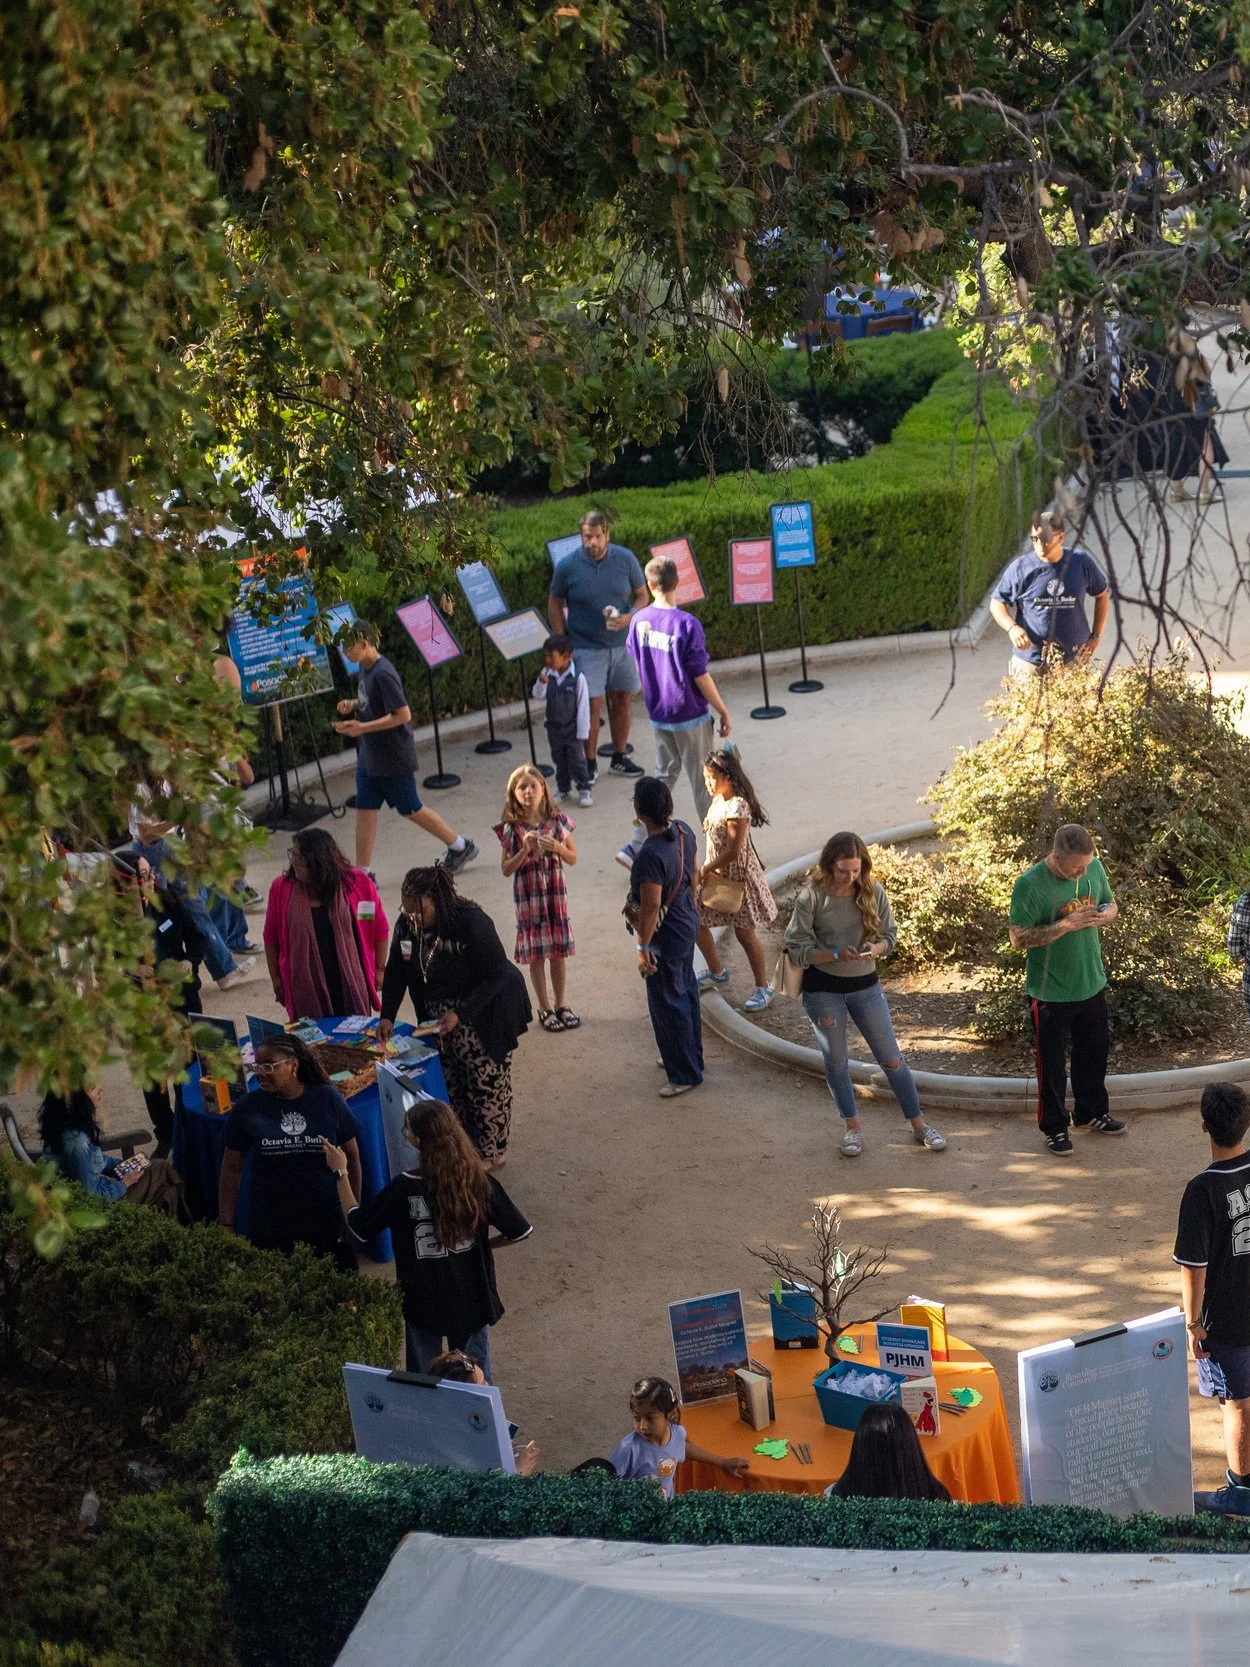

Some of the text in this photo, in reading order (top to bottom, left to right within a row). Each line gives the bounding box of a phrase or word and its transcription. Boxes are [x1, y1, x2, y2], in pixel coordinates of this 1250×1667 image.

[261, 1137, 292, 1146] Octavia
[294, 1136, 303, 1144] E.
[414, 1221, 477, 1260] 2
[719, 1320, 737, 1329] Magnet
[726, 1328, 744, 1336] connect
[728, 1334, 737, 1342] and
[886, 1352, 925, 1367] PJHM
[693, 1377, 727, 1389] Pasadena
[1091, 1394, 1121, 1411] Magnet
[1097, 1405, 1119, 1421] place
[1119, 1397, 1148, 1412] because
[1075, 1423, 1087, 1435] the
[1089, 1418, 1115, 1433] people
[1135, 1405, 1152, 1417] Our
[1101, 1427, 1116, 1437] our
[1081, 1440, 1099, 1453] staff
[1118, 1427, 1145, 1443] always
[1092, 1443, 1122, 1459] around
[1123, 1437, 1144, 1450] those
[1068, 1463, 1086, 1477] with
[1087, 1459, 1100, 1470] the
[1100, 1451, 1131, 1468] greatest
[1099, 1463, 1124, 1477] return
